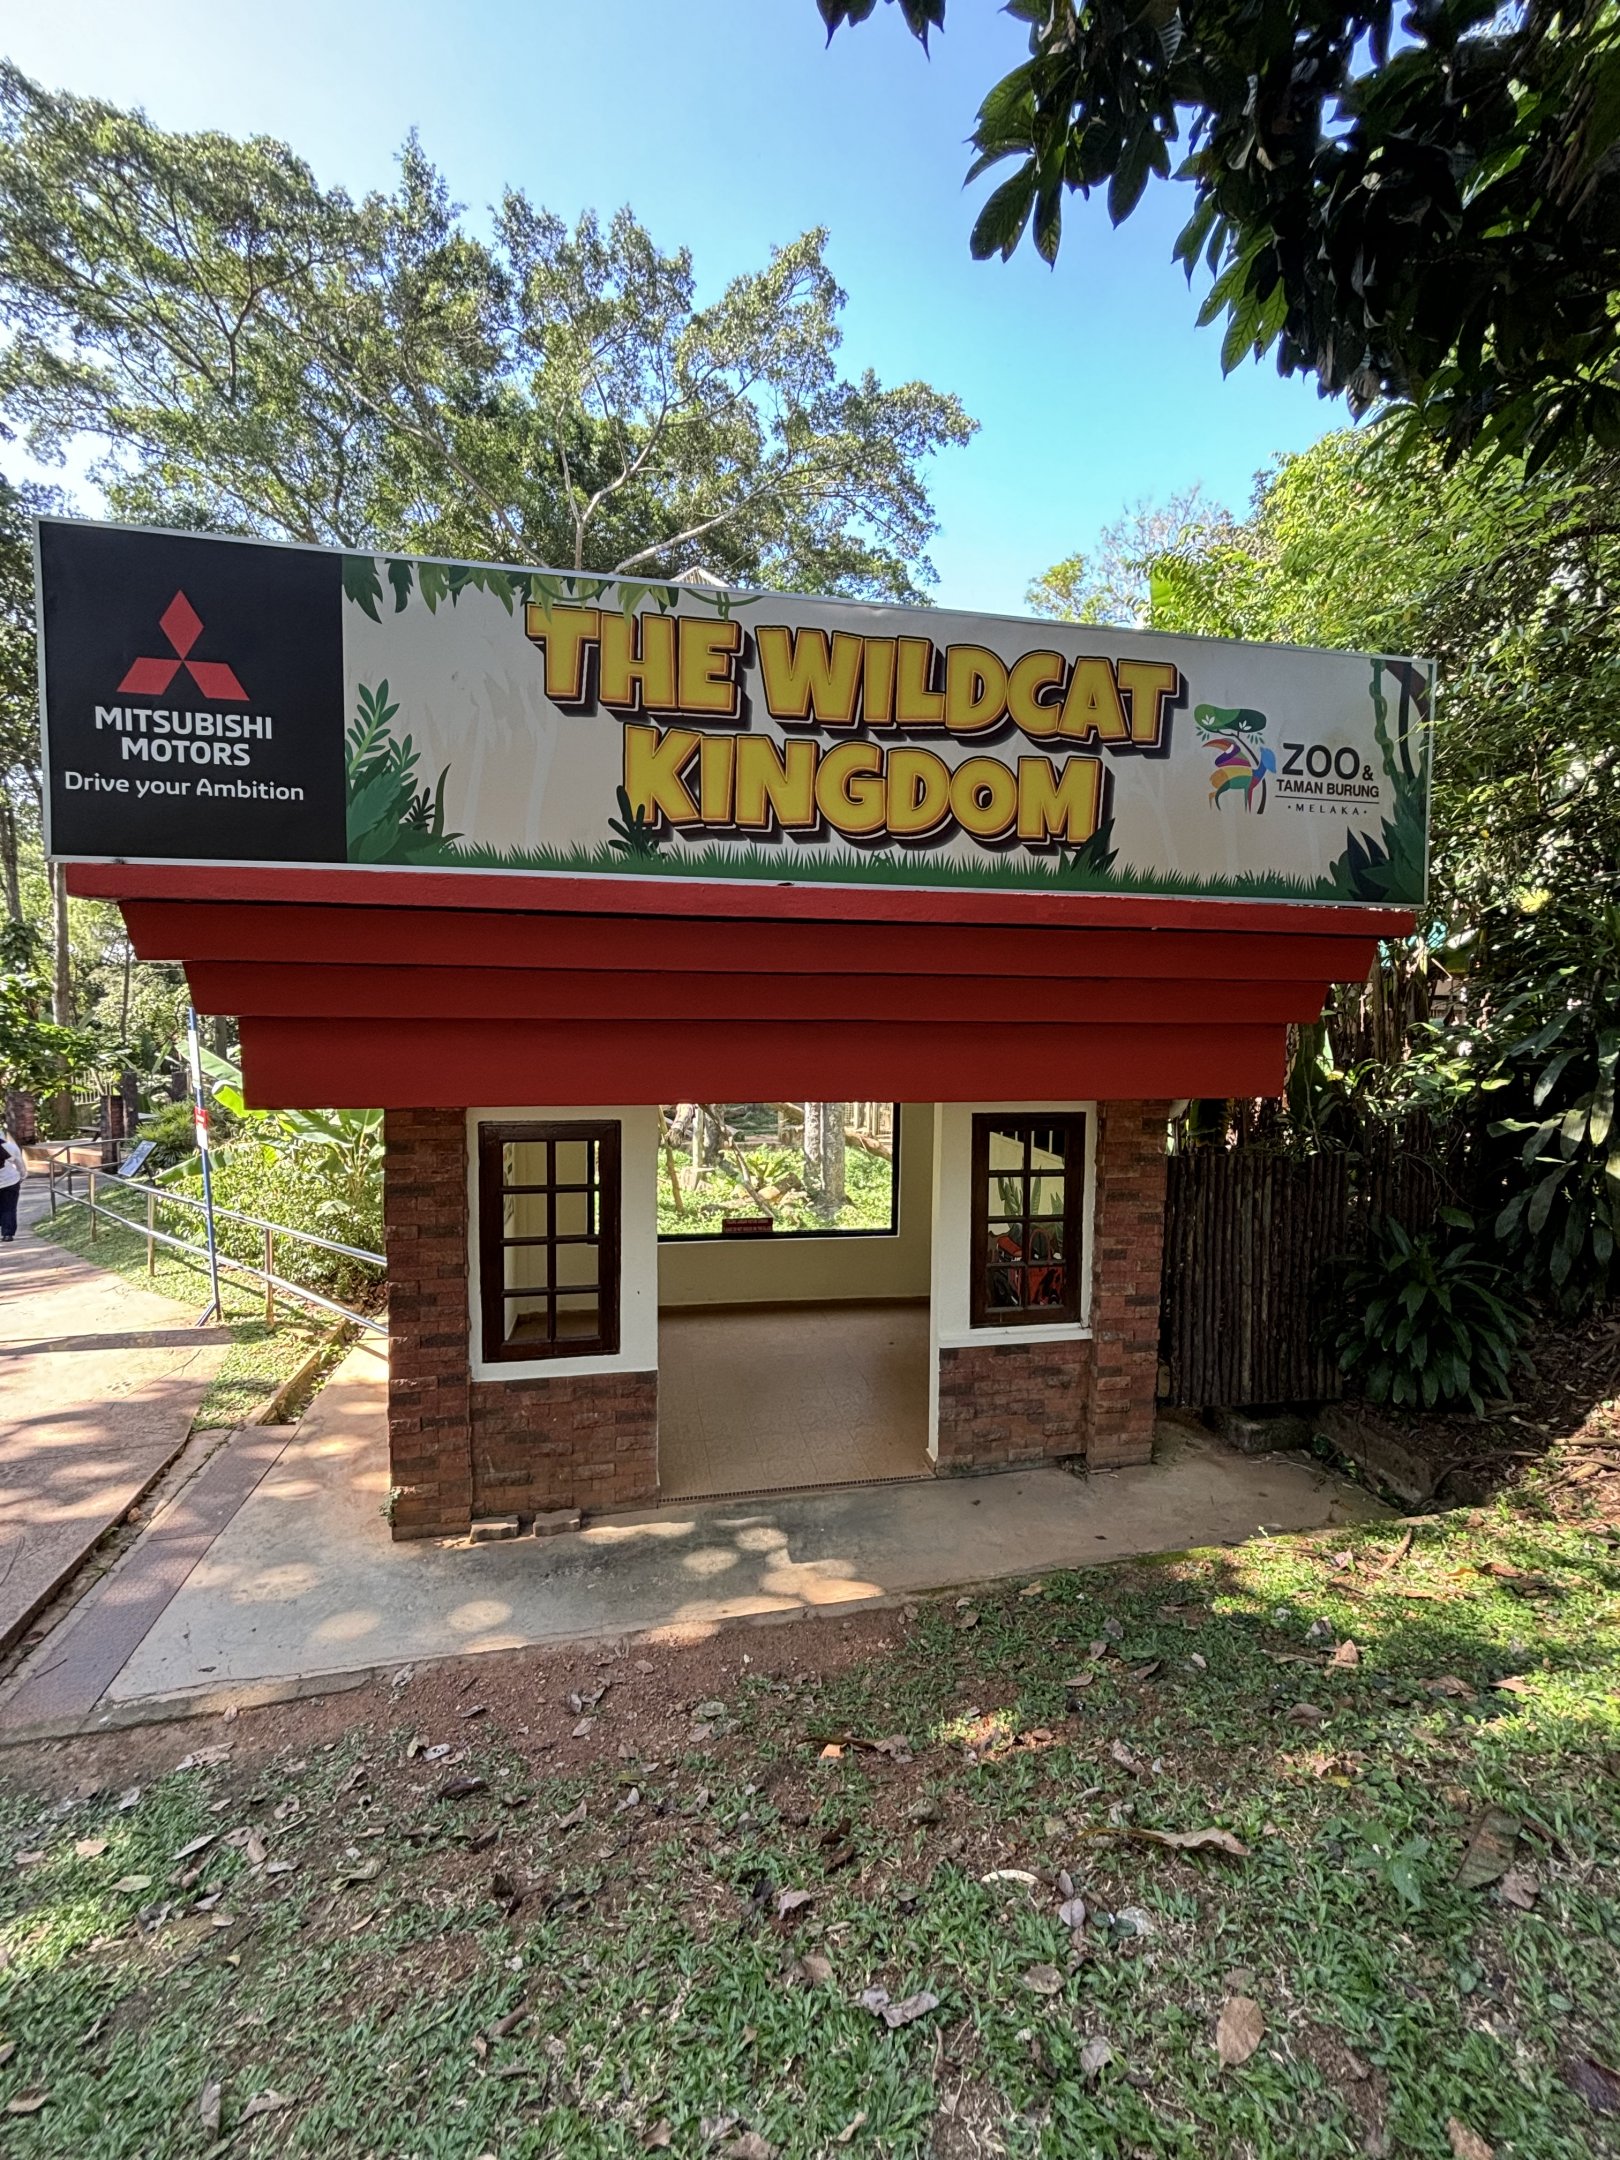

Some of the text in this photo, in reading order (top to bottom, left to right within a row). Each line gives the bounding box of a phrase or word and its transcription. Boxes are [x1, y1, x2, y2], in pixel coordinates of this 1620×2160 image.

[525, 601, 1180, 746] THE WILDCAT
[94, 705, 273, 740] MITSUBISHI
[121, 736, 251, 767] MOTORS
[1282, 742, 1360, 780] ZOO
[64, 770, 304, 801] Drive your Ambition
[623, 722, 1103, 847] KINGDOM
[1276, 778, 1380, 798] TAMAN BURUNG
